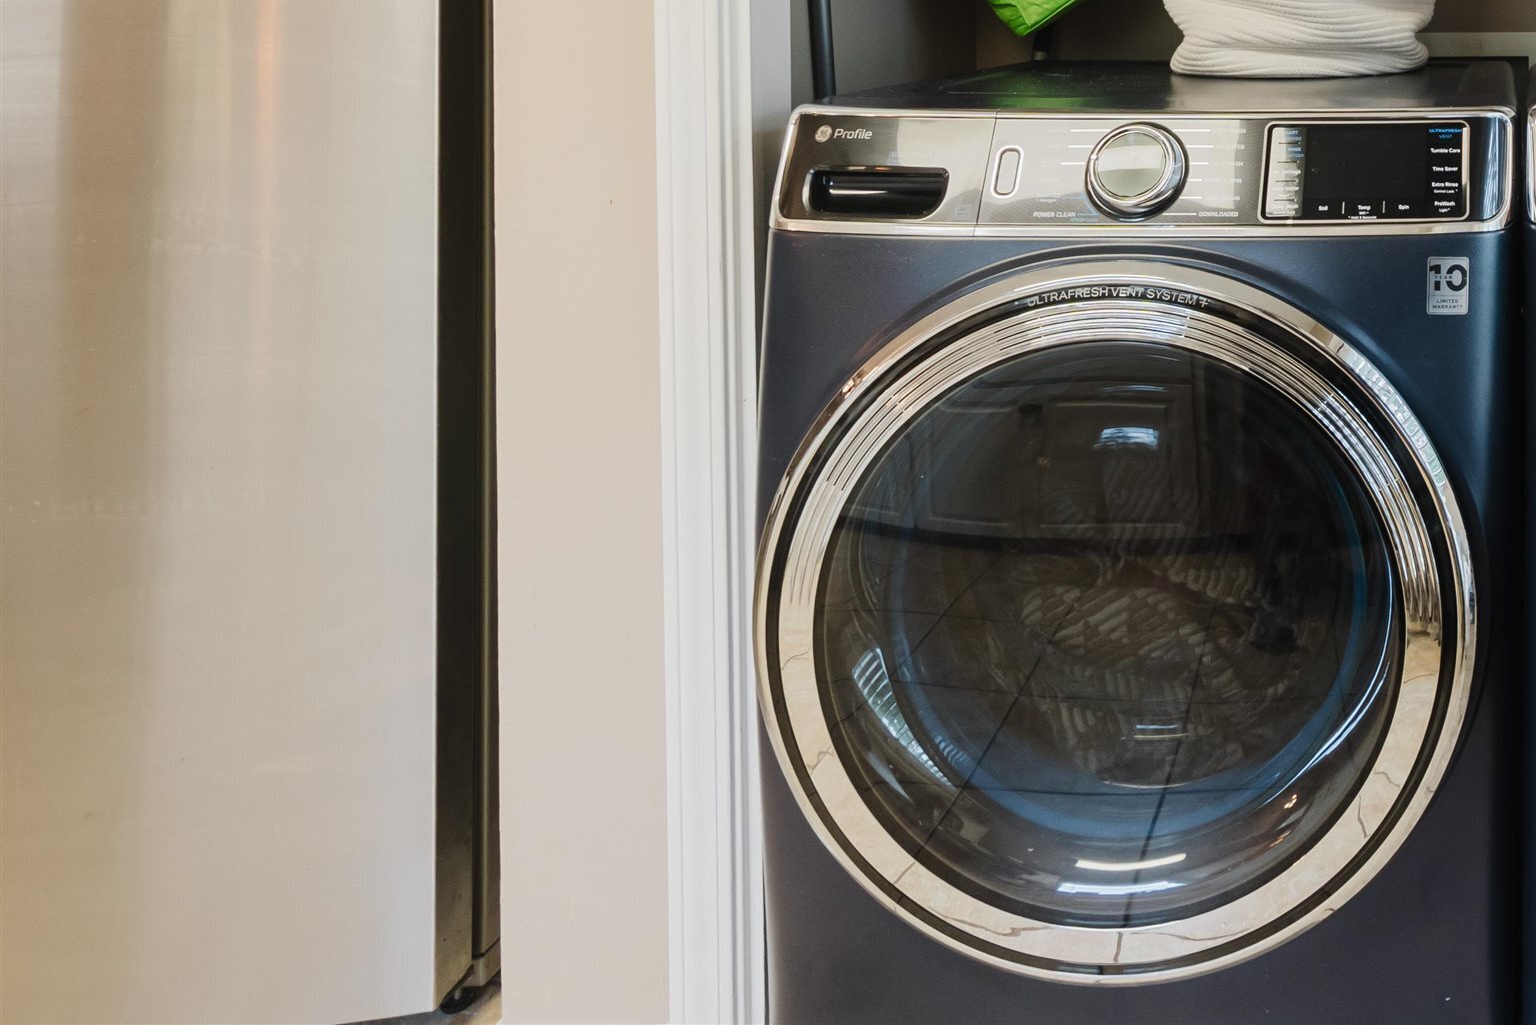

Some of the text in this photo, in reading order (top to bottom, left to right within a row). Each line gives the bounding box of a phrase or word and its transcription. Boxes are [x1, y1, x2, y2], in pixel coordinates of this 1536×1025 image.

[833, 128, 873, 140] Profile
[1430, 264, 1467, 292] 10
[1027, 286, 1109, 307] ULTRAFRESH
[1111, 286, 1146, 298] VENT
[1146, 288, 1198, 306] SYSTEM
